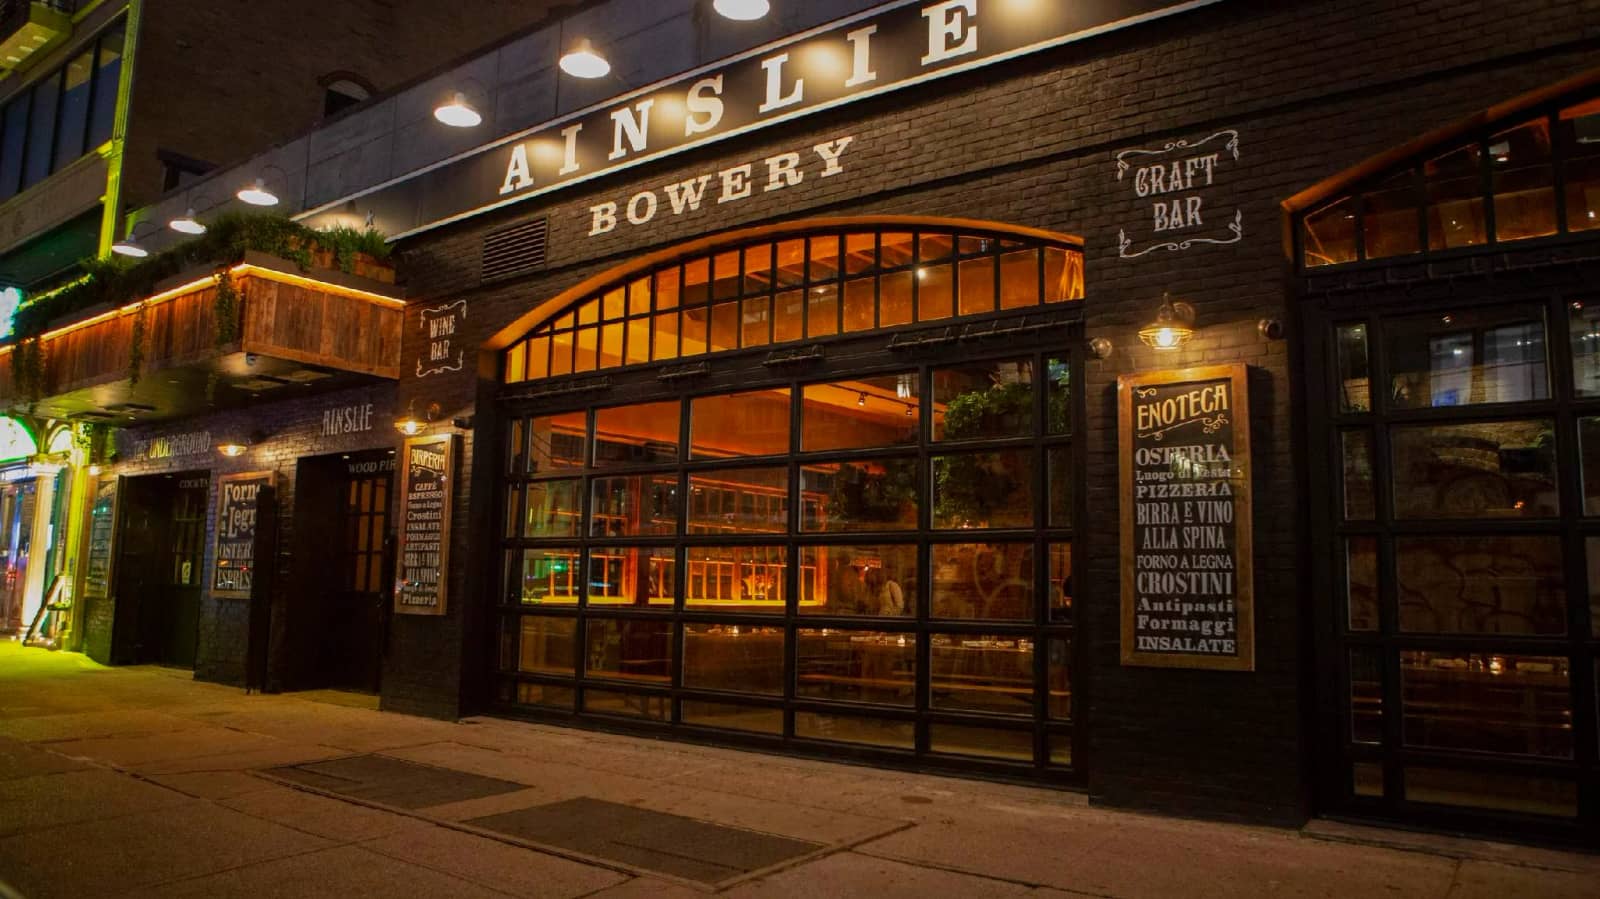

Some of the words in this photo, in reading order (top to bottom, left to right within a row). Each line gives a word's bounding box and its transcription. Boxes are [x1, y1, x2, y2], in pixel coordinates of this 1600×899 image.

[499, 0, 978, 196] AINSLIE
[588, 136, 853, 237] BOWERY
[1135, 153, 1218, 197] CRAFT
[1153, 196, 1203, 232] BAR
[430, 314, 455, 338] WINE
[431, 340, 450, 360] BAR
[1137, 383, 1228, 431] ENOTECA
[322, 404, 373, 436] AINSLIE
[1135, 443, 1231, 466] OSTERIA
[1136, 470, 1174, 482] Luogo
[1136, 482, 1232, 499] PIZZERIA
[1137, 502, 1179, 525] BIRRA
[1184, 501, 1192, 517] E
[1197, 501, 1232, 523] VINO
[1143, 528, 1178, 550] ALLA
[1183, 527, 1225, 549] SPINA
[1137, 556, 1177, 569] FORNO
[1180, 556, 1190, 569] A
[1192, 555, 1233, 569] LEGNA
[1137, 572, 1232, 595] CROSTINI
[1137, 597, 1233, 615] Antipasti
[1137, 614, 1234, 636] Formaggi
[1137, 636, 1235, 653] INSALATE
